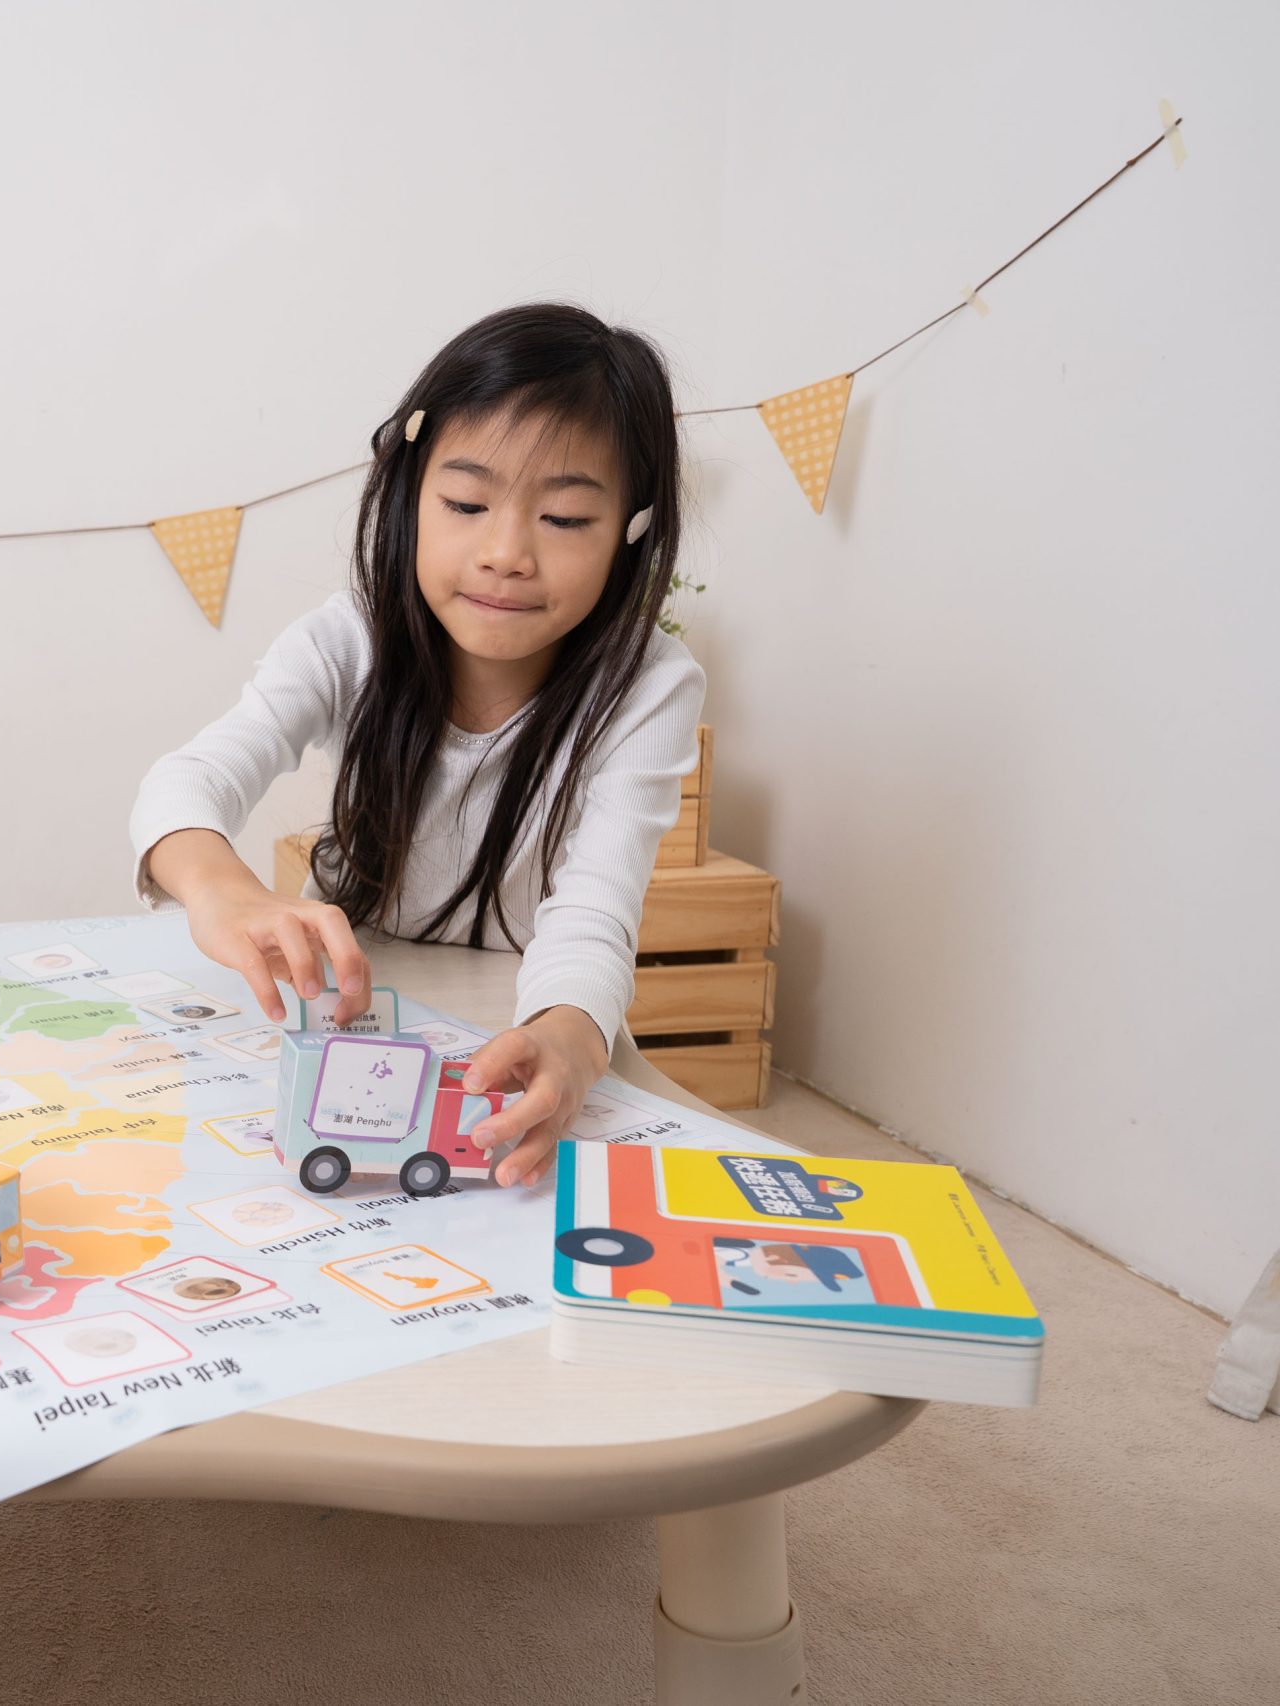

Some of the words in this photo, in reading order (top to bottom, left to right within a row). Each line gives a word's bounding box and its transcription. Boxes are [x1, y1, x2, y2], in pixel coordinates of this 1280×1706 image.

[2, 976, 77, 990] Kaohsiung
[29, 1013, 80, 1025] Tainan
[118, 1031, 167, 1043] Chiayi
[112, 1054, 169, 1070] Yunlin
[211, 1072, 250, 1084] 彰化
[125, 1077, 212, 1100] Changhua
[28, 1104, 65, 1118] 南投
[333, 1113, 354, 1124] 澎湖
[356, 1116, 392, 1128] Penghu
[121, 1117, 159, 1130] 台中
[645, 1120, 682, 1135] 金門
[31, 1125, 118, 1147] Taichung
[727, 1157, 803, 1217] 快遞任務
[355, 1191, 422, 1212] Miaoli
[349, 1216, 393, 1233] 新竹
[259, 1226, 346, 1256] Hsinchu
[271, 1302, 322, 1321] 台北
[483, 1292, 535, 1312] 桃園
[391, 1297, 487, 1327] Taoyuan
[195, 1314, 271, 1337] Taipei
[193, 1356, 243, 1383] 新北
[122, 1371, 181, 1397] New
[33, 1388, 118, 1432] Taipei
